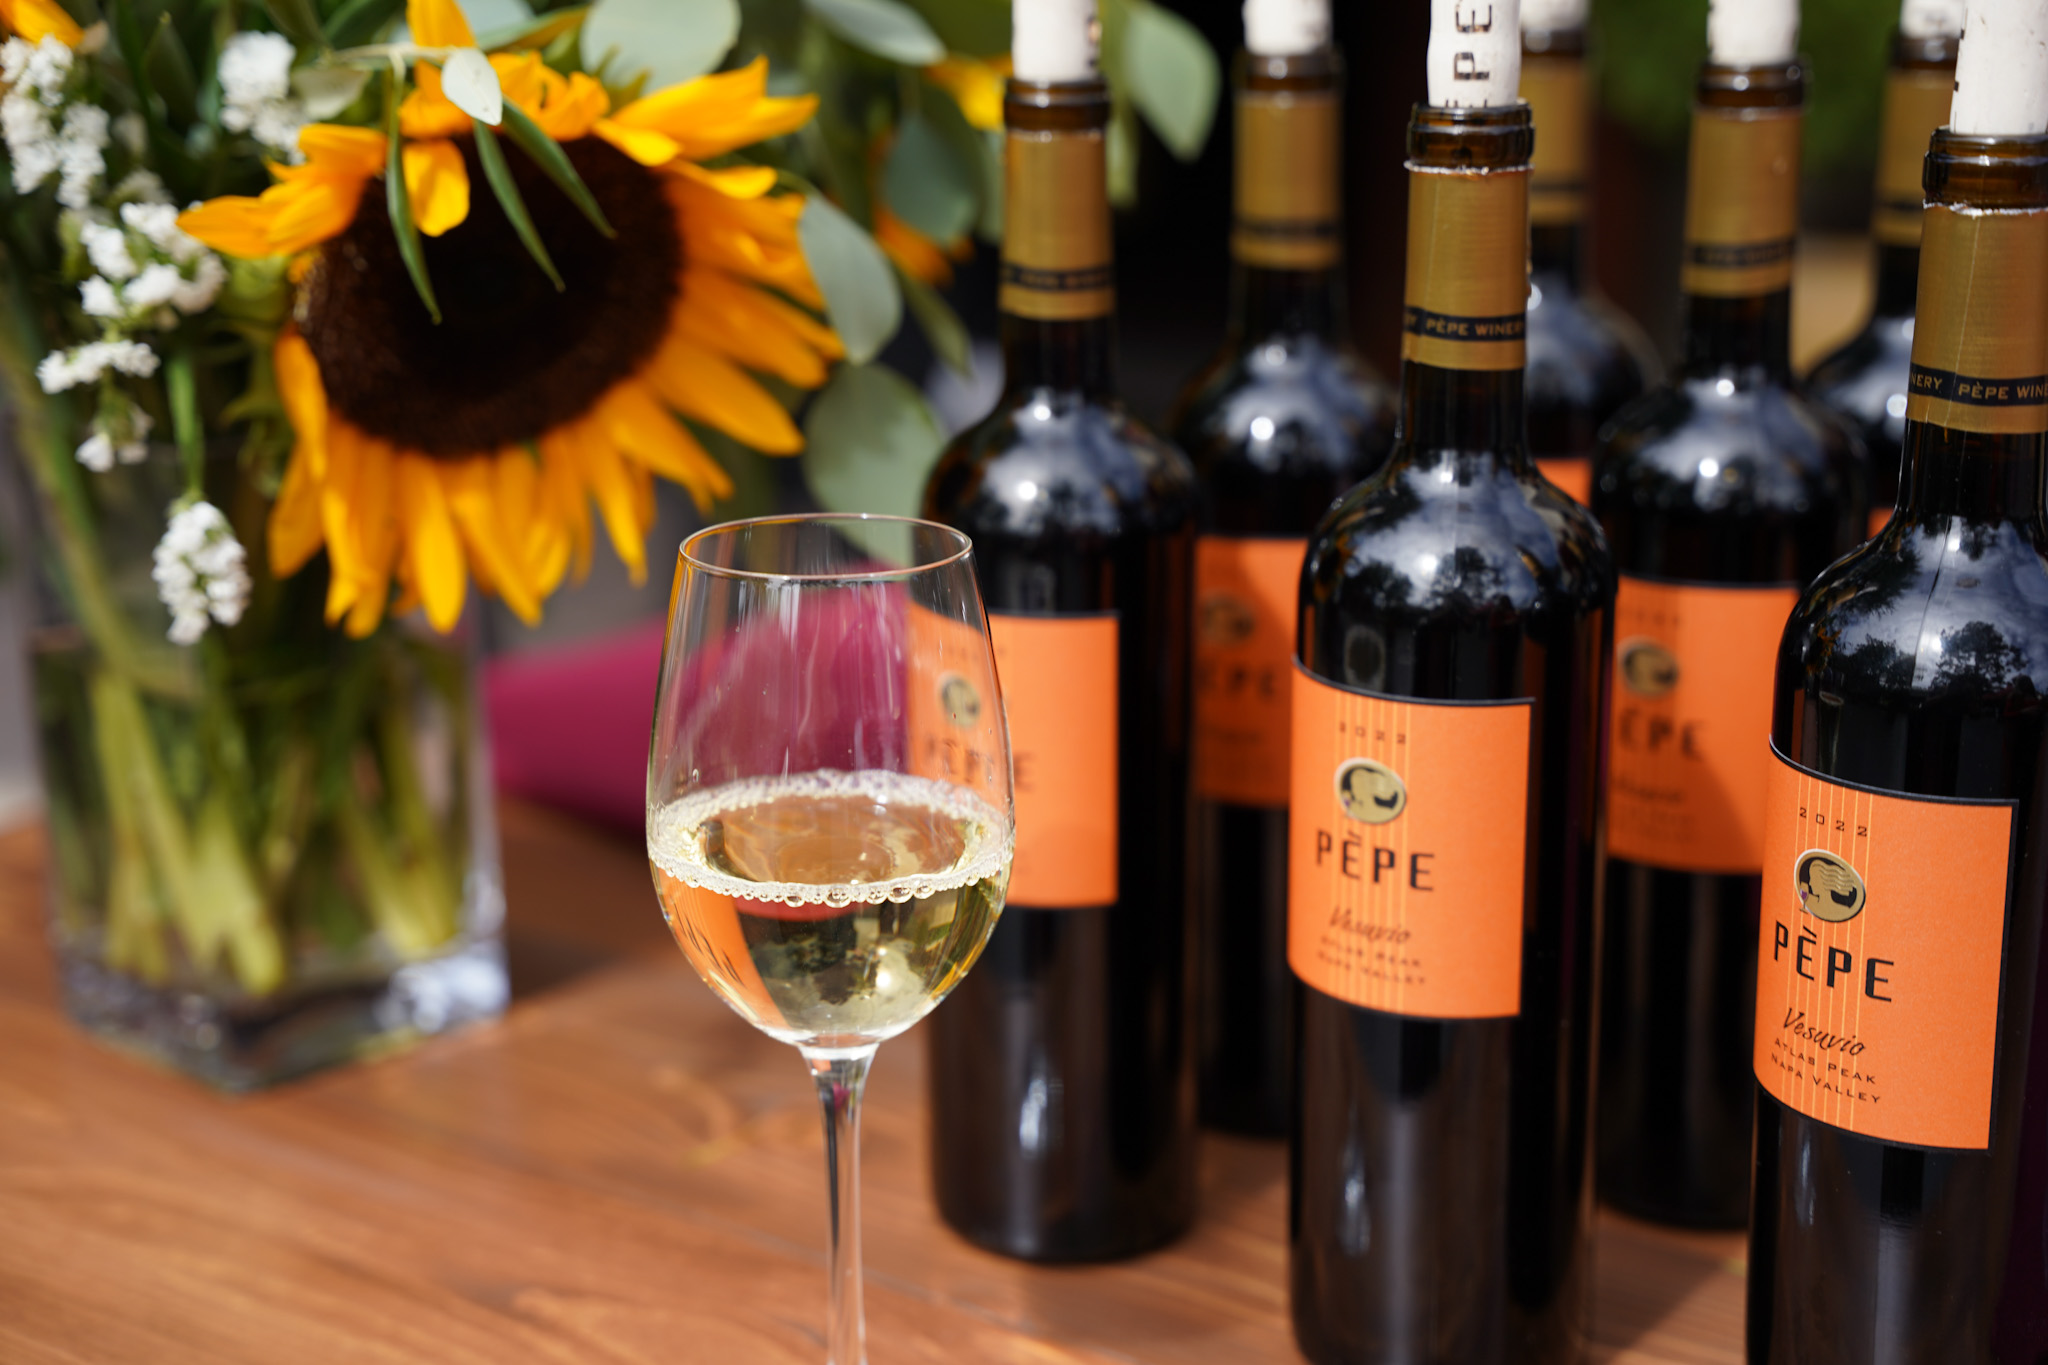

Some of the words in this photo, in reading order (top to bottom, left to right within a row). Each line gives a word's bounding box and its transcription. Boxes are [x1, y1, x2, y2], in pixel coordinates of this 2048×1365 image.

[1426, 317, 1469, 337] PÈPE
[1958, 380, 2009, 400] PÈPE
[1799, 806, 1868, 838] 2022
[1316, 828, 1436, 892] PÈPE
[1330, 904, 1411, 944] Vesuvio
[1773, 919, 1895, 1003] PÈPE
[1783, 1006, 1866, 1057] Vesuvio
[1770, 1051, 1804, 1081] NAPA
[1812, 1073, 1881, 1105] VALLEY
[1774, 1036, 1817, 1067] ATLAS
[1827, 1061, 1877, 1085] PEAK
